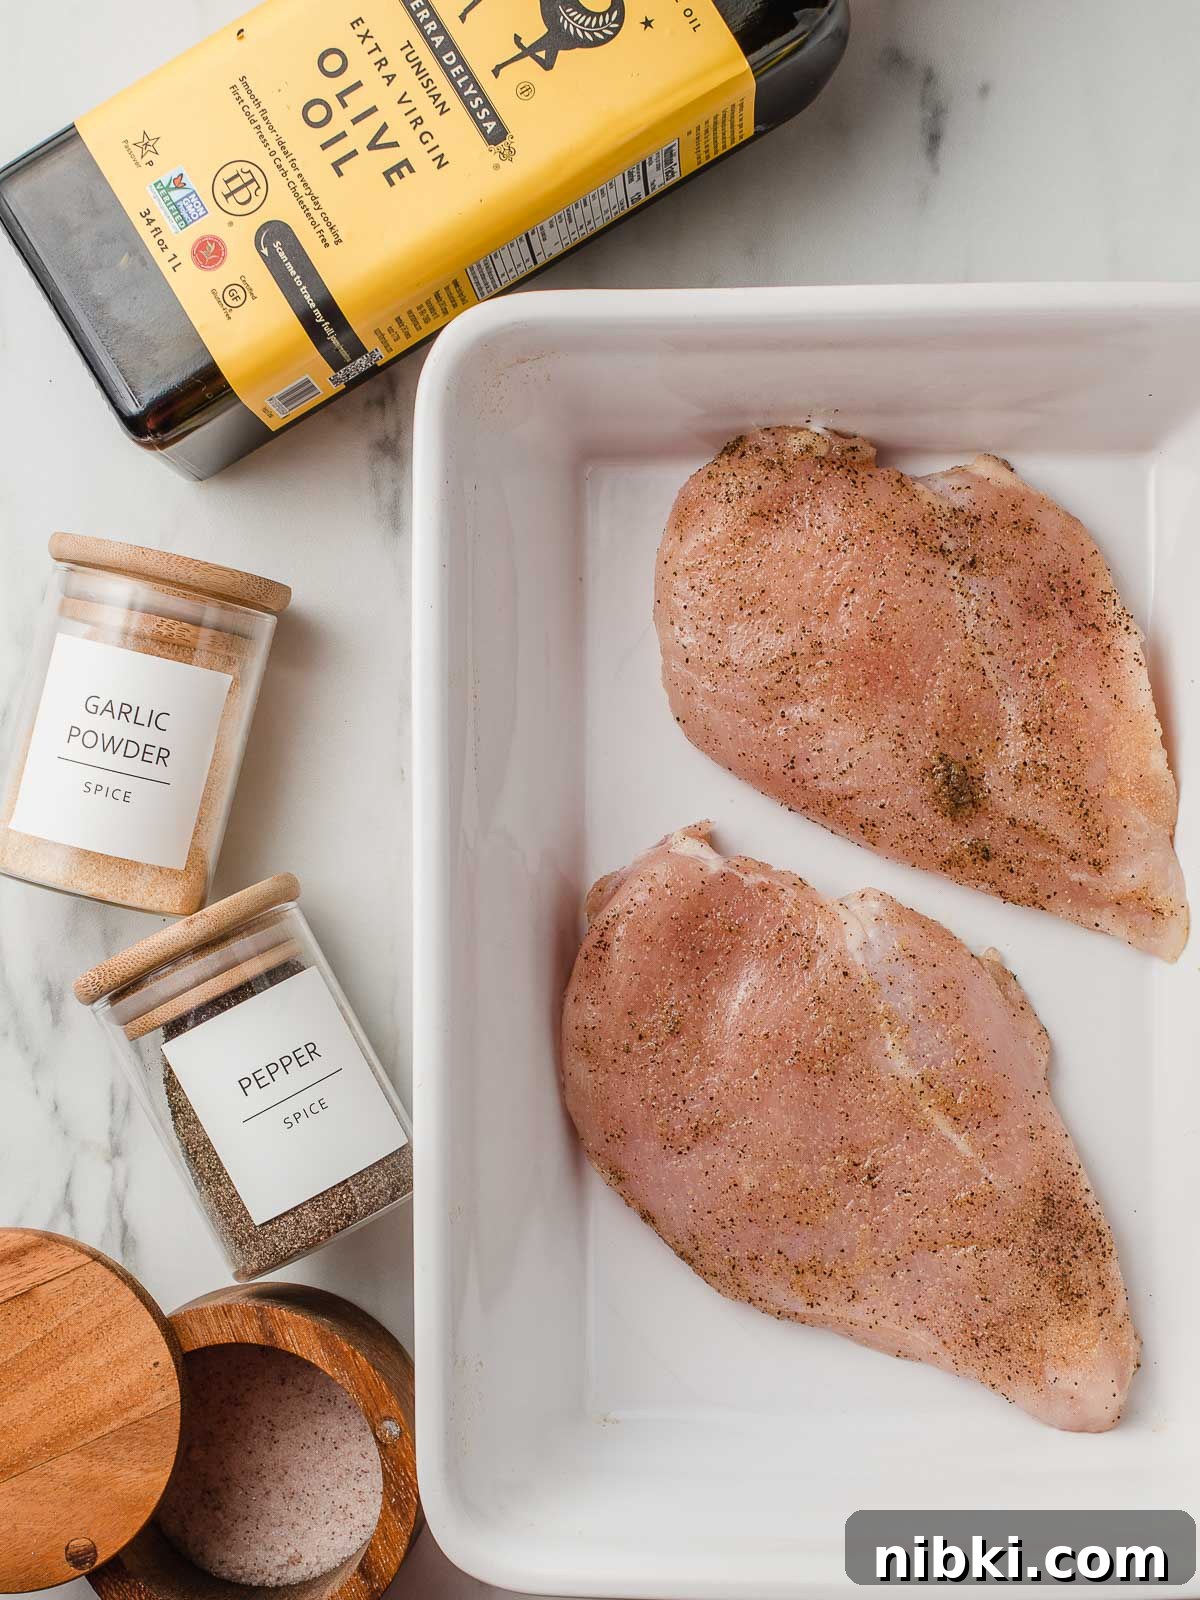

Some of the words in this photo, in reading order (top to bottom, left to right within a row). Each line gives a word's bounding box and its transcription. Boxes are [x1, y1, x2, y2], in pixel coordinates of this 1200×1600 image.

[683, 8, 701, 33] OIL
[350, 16, 397, 87] EXTRA
[396, 91, 449, 171] VIRGIN
[400, 40, 450, 116] TUNISIAN
[442, 51, 497, 134] DELYSSA
[317, 47, 416, 188] OLIVE
[122, 139, 142, 168] Passover
[301, 98, 359, 178] OIL
[229, 84, 244, 105] First
[241, 104, 258, 125] Cold
[316, 228, 330, 249] Free
[238, 75, 262, 109] Smooth
[288, 158, 300, 172] for
[297, 173, 323, 211] everyday
[320, 211, 344, 246] cooking
[139, 208, 156, 227] 34
[156, 182, 186, 228] VERIFIED
[183, 198, 200, 220] GMO
[189, 193, 207, 216] NON
[150, 226, 163, 239] fl
[157, 238, 169, 252] oz
[167, 253, 178, 263] 1
[171, 261, 182, 273] L
[228, 288, 241, 302] GF
[239, 275, 258, 300] Certified
[273, 240, 288, 263] Scan
[285, 261, 297, 277] me
[293, 275, 303, 287] to
[300, 285, 316, 309] trace
[313, 307, 325, 323] my
[321, 321, 334, 336] full
[84, 695, 171, 732] GARLIC
[66, 725, 171, 768] POWDER
[83, 781, 132, 803] SPICE
[237, 1041, 322, 1097] PEPPER
[283, 1098, 329, 1130] SPICE
